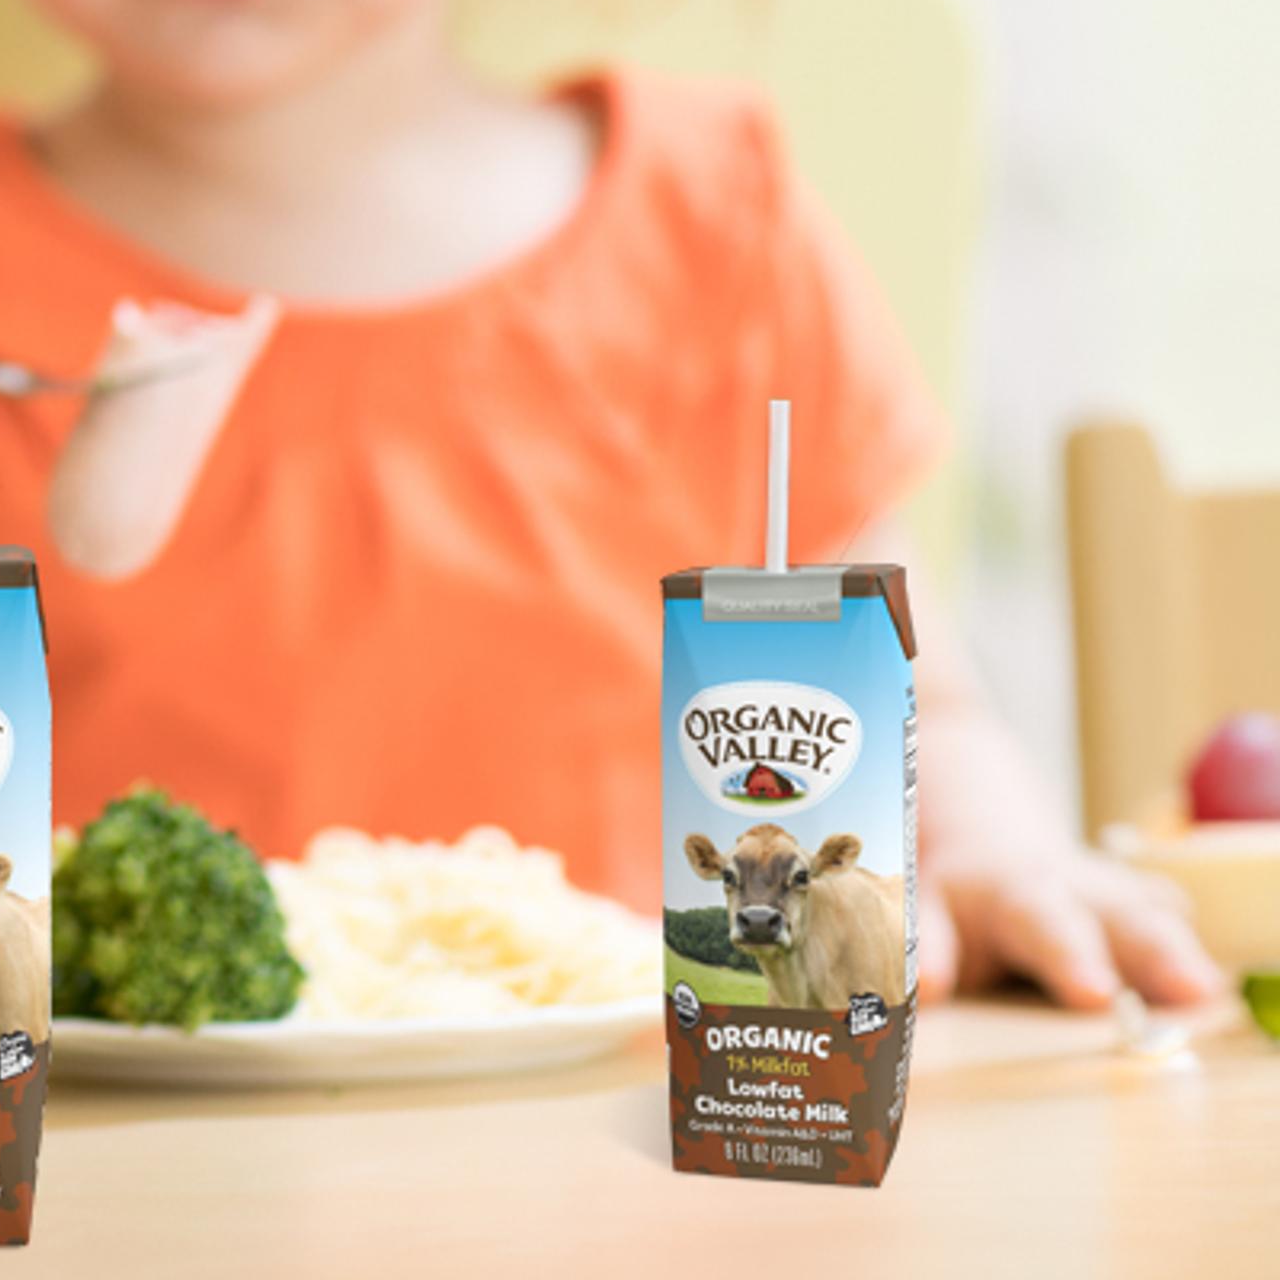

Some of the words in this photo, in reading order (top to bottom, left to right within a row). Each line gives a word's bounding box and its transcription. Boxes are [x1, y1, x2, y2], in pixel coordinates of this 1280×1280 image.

[684, 704, 852, 744] ORGANIC
[697, 736, 833, 772] VALLEY
[706, 1024, 832, 1059] ORGANIC
[726, 1055, 749, 1072] 1%
[752, 1055, 810, 1077] Milkfat
[727, 1078, 804, 1100] Lowfat
[694, 1095, 801, 1122] Chocolate
[805, 1104, 848, 1124] Milk
